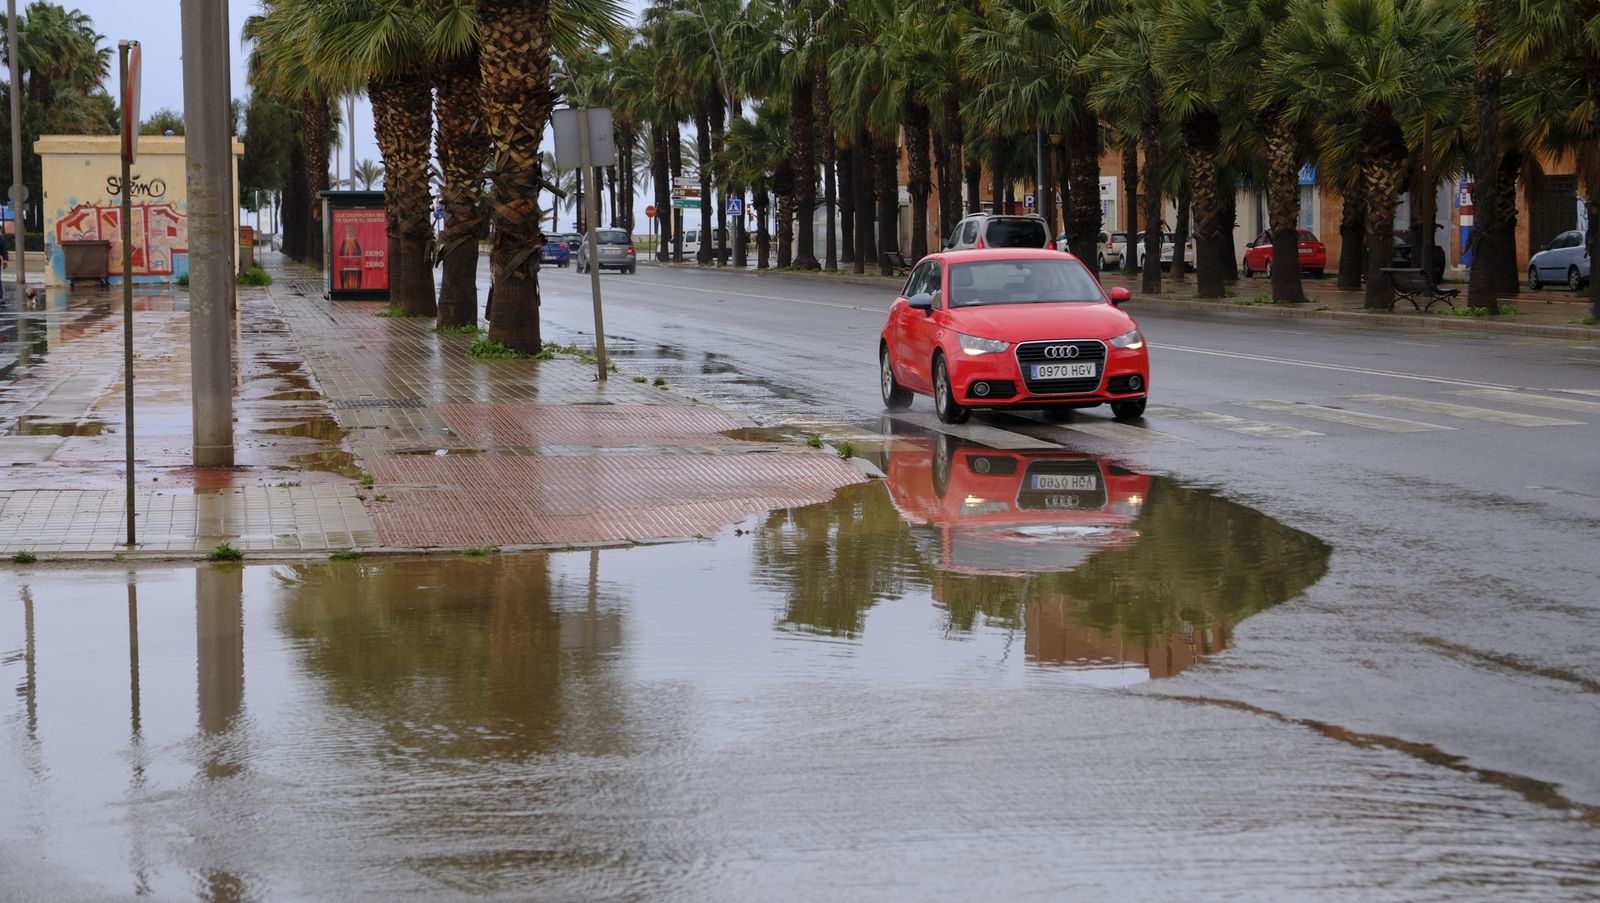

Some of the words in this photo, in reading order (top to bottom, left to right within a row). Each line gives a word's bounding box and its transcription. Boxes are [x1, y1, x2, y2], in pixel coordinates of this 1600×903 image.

[1025, 195, 1035, 208] P
[1039, 365, 1067, 377] 0970
[1071, 364, 1092, 376] HGV
